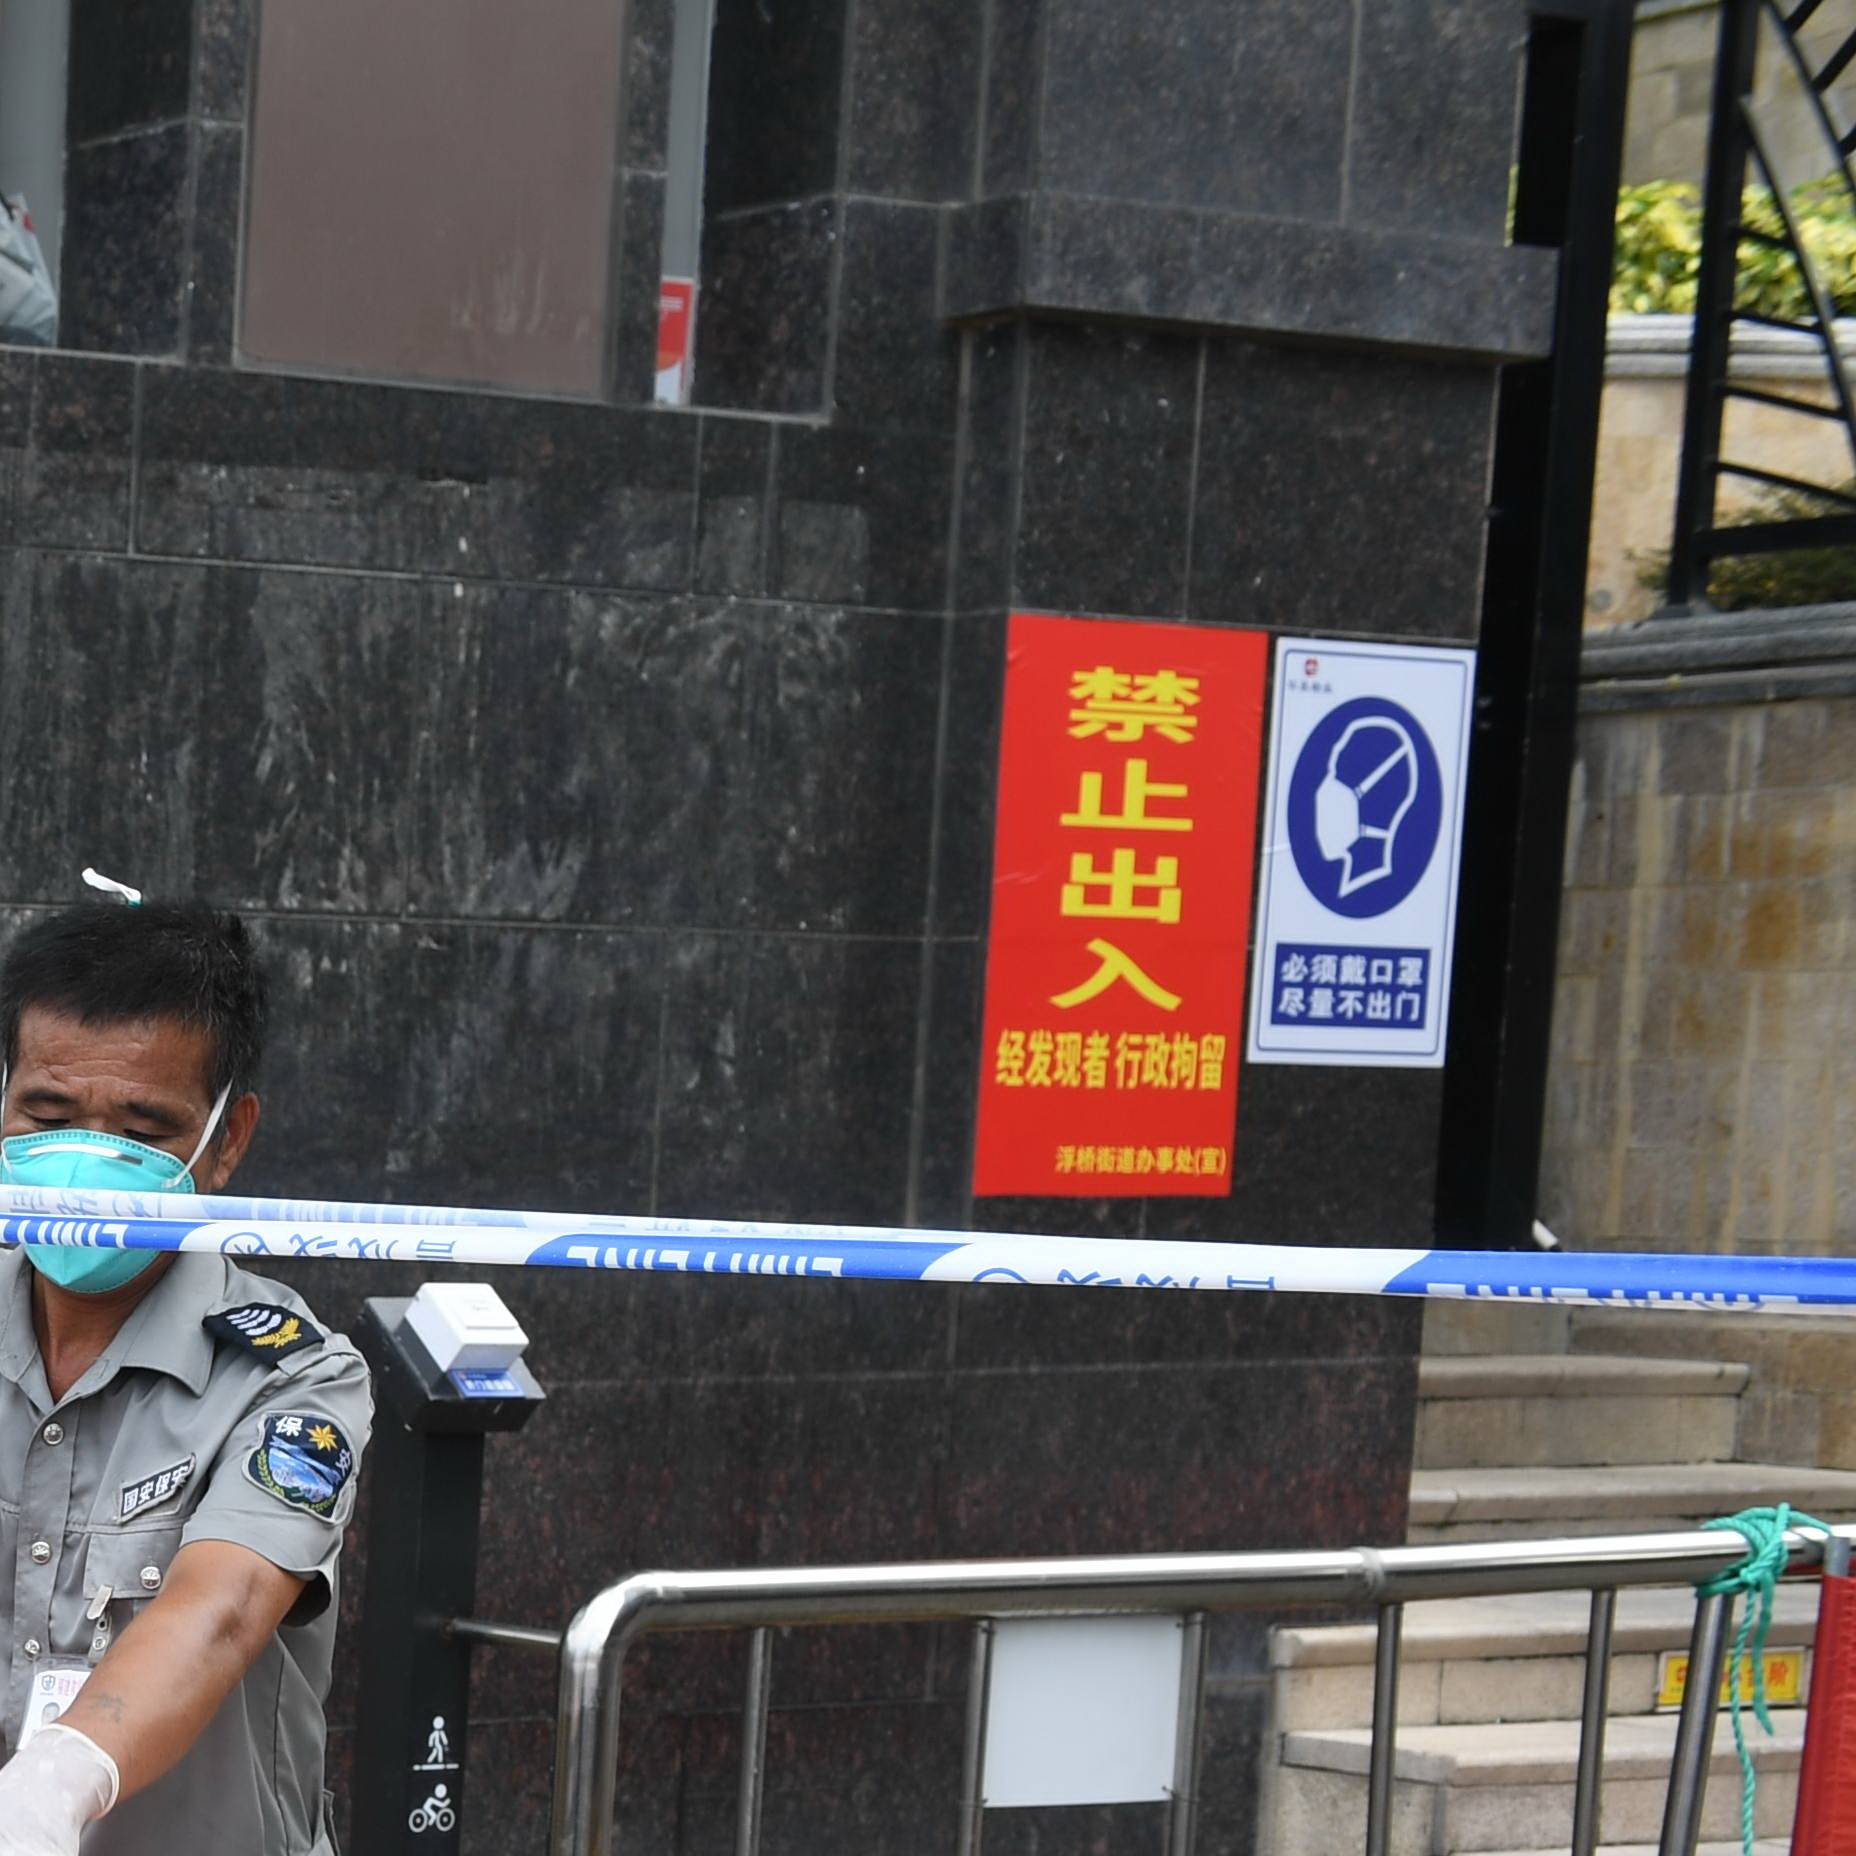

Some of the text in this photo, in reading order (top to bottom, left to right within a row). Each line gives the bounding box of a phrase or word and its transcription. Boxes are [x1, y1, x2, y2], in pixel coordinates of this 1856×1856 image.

[1049, 665, 1200, 1012] 禁止出入
[1280, 952, 1423, 987] 必须戴口罩
[1277, 987, 1420, 1021] 尽量不出门
[995, 1029, 1226, 1090] 经发现者 行政拘留
[275, 1415, 303, 1437] 保
